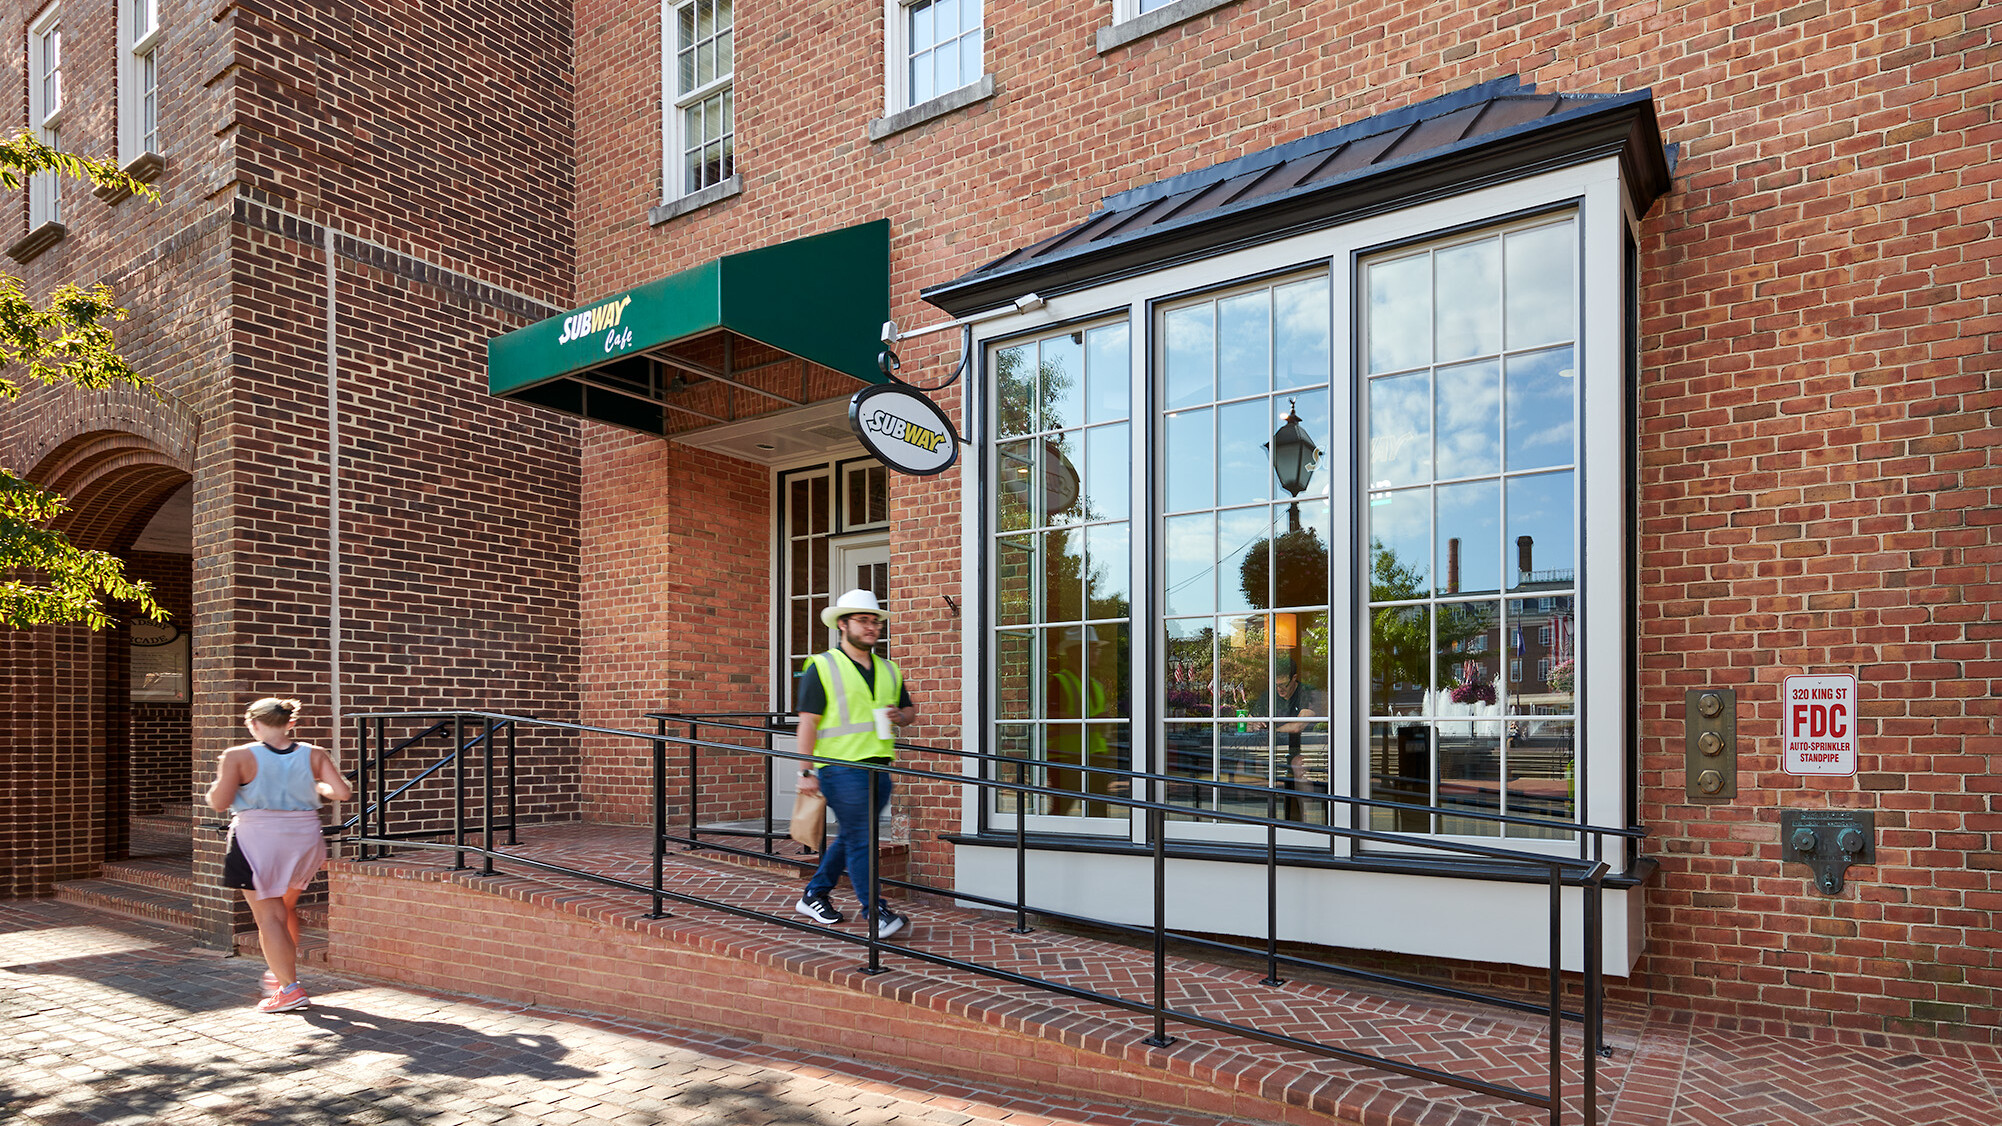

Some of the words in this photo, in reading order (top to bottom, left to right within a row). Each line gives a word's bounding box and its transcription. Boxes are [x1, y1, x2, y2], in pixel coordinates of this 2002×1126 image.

[559, 295, 632, 345] SUBWAY
[866, 409, 946, 454] SUBWAY
[1792, 688, 1809, 700] 320
[1811, 688, 1833, 700] KING
[1835, 688, 1847, 700] ST
[1793, 703, 1846, 738] FDC
[1789, 742, 1850, 751] AUTO-SPRINKLER
[1800, 753, 1839, 762] STANDPIPE
